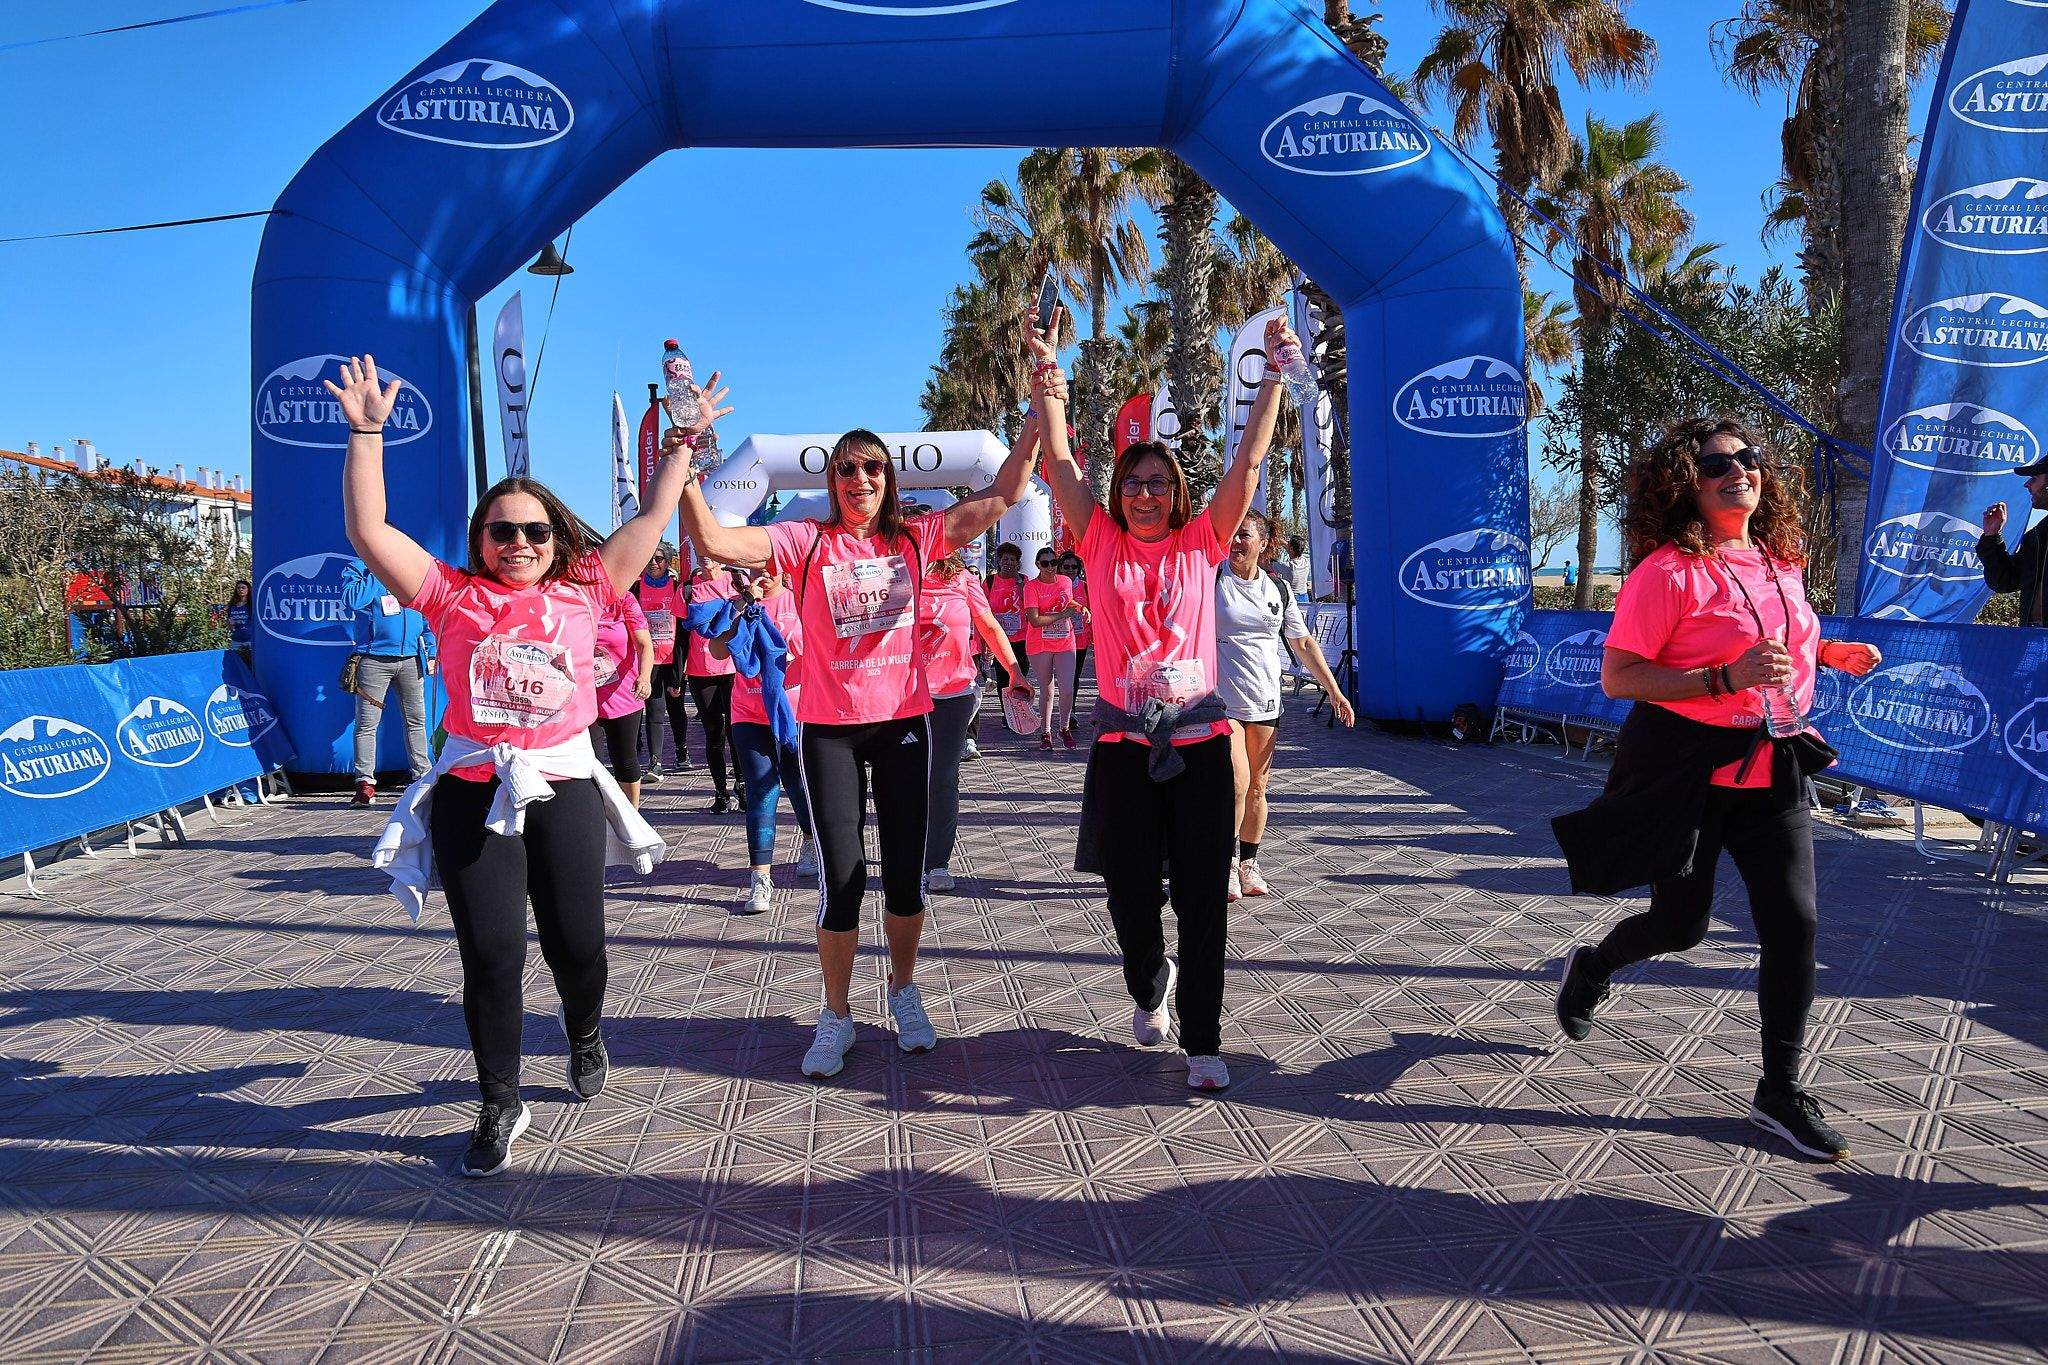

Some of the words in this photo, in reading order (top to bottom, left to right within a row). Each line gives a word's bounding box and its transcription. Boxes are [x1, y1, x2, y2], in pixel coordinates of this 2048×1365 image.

[420, 86, 481, 97] CENTRAL
[487, 87, 552, 102] LECHERA
[1996, 80, 2048, 89] CENTRA
[387, 94, 559, 132] ASTURIANA
[1304, 119, 1361, 131] CENTRAL
[1366, 119, 1412, 131] LECHERA
[1275, 126, 1424, 158] ASTURIANA
[1966, 203, 2022, 212] CENTRAL
[2026, 204, 2048, 213] LEC
[1934, 205, 2048, 235] ASTURIA
[1939, 315, 1996, 326] CENTRAL
[1912, 316, 2048, 352] ASTURIANA
[280, 386, 331, 396] CENTRA
[1432, 384, 1486, 394] CENTRAL
[261, 391, 420, 431] ASTURNA
[1406, 389, 1525, 421] ASTURIANA
[1916, 423, 1968, 435] CENTRAL
[1972, 429, 2025, 442] LECHERA
[1892, 425, 2026, 464] ASTURIANA
[645, 429, 655, 483] ander
[799, 444, 943, 475] OHO
[713, 480, 758, 490] OYSHO
[1009, 531, 1048, 542] OYSHO
[1897, 531, 1939, 544] CENTRAL
[1941, 537, 1976, 549] LECHE
[1438, 557, 1491, 567] CENTRAL
[1411, 560, 1530, 591] ASTURIANA
[281, 584, 340, 594] CENTRAL
[858, 588, 890, 605] 016
[262, 586, 356, 621] ASTUR
[830, 659, 865, 671] CARRERA
[866, 658, 876, 669] DE
[877, 658, 887, 667] LA
[1550, 648, 1602, 673] ASTURIA
[504, 676, 544, 695] 016
[1731, 714, 1762, 727] CARR
[1856, 686, 1972, 737] ASTURIANA
[14, 743, 55, 757] CENTRAL
[55, 736, 93, 749] LECHERA
[128, 724, 201, 757] ASTURIANA
[2, 746, 106, 786] ASTURIANA
